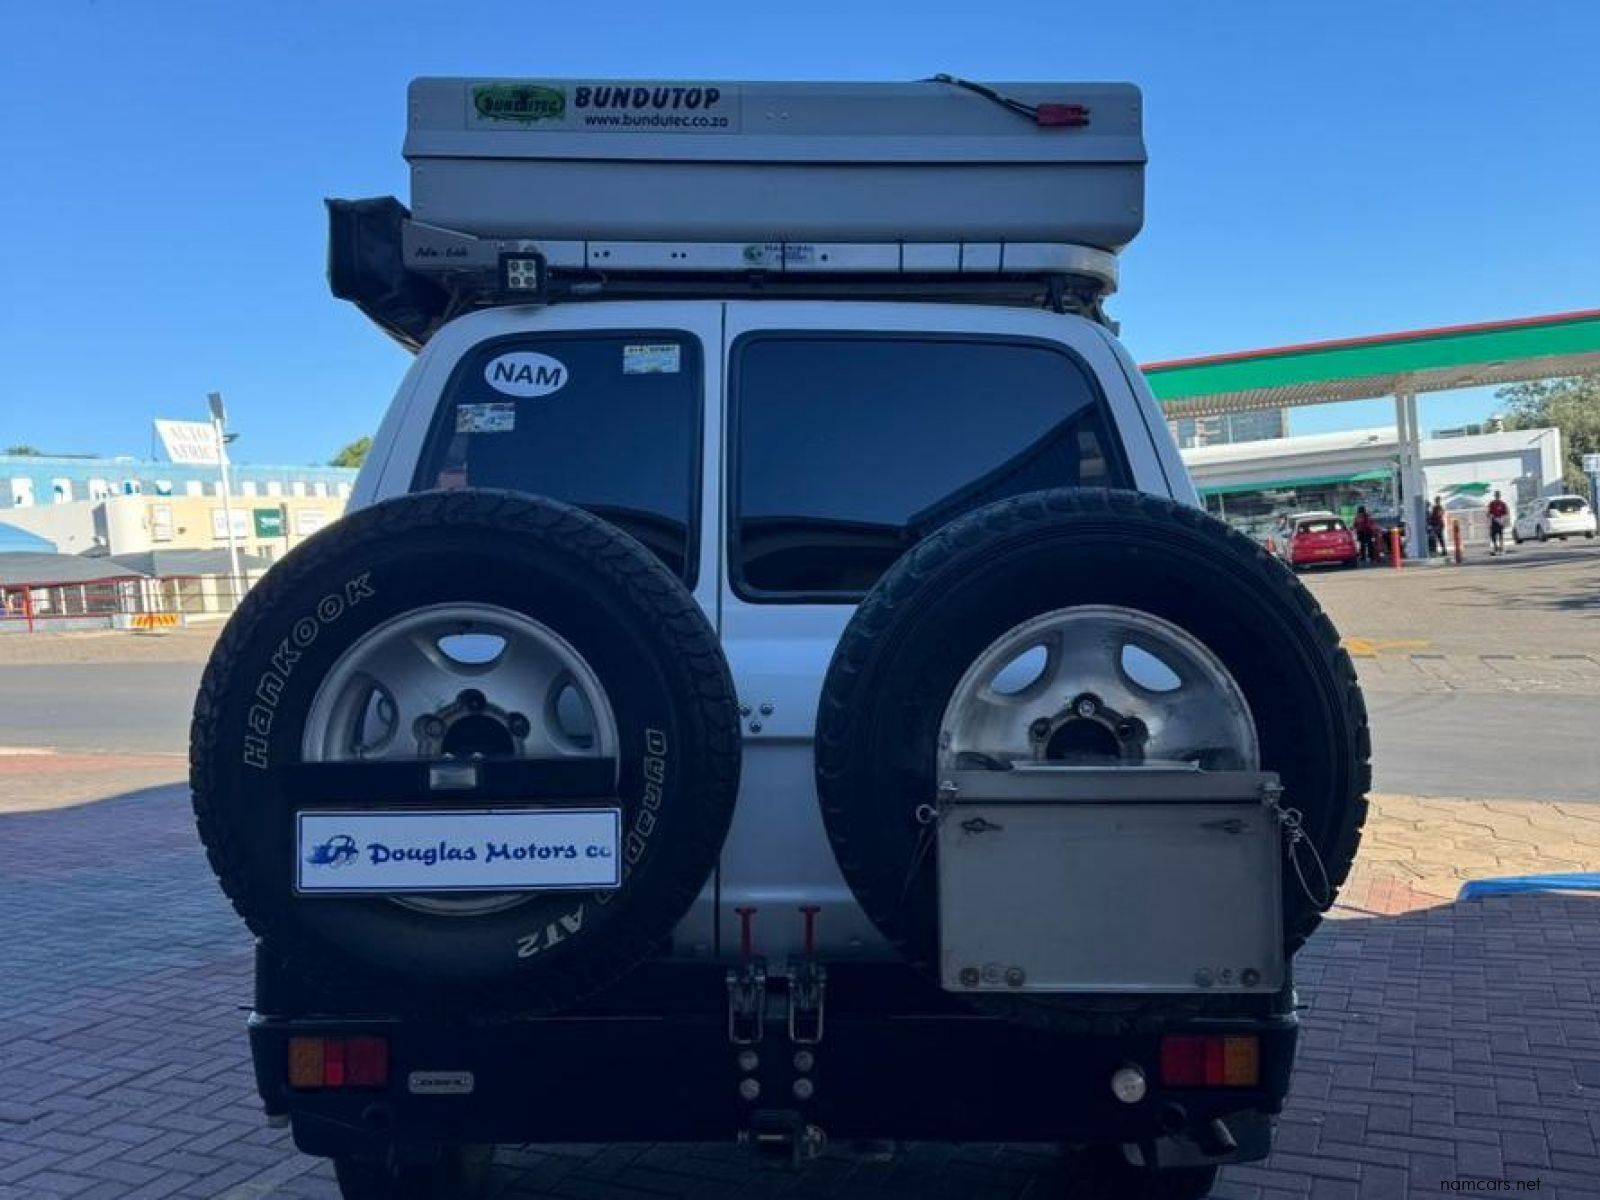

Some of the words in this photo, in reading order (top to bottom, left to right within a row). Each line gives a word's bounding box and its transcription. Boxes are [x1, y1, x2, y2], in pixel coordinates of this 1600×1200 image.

[575, 87, 720, 109] BUNDUTOP
[585, 114, 728, 127] www.bundutec.co.za
[494, 363, 562, 386] NAM
[367, 841, 476, 865] Douglas
[485, 841, 577, 863] Motors
[518, 903, 584, 958] AT2
